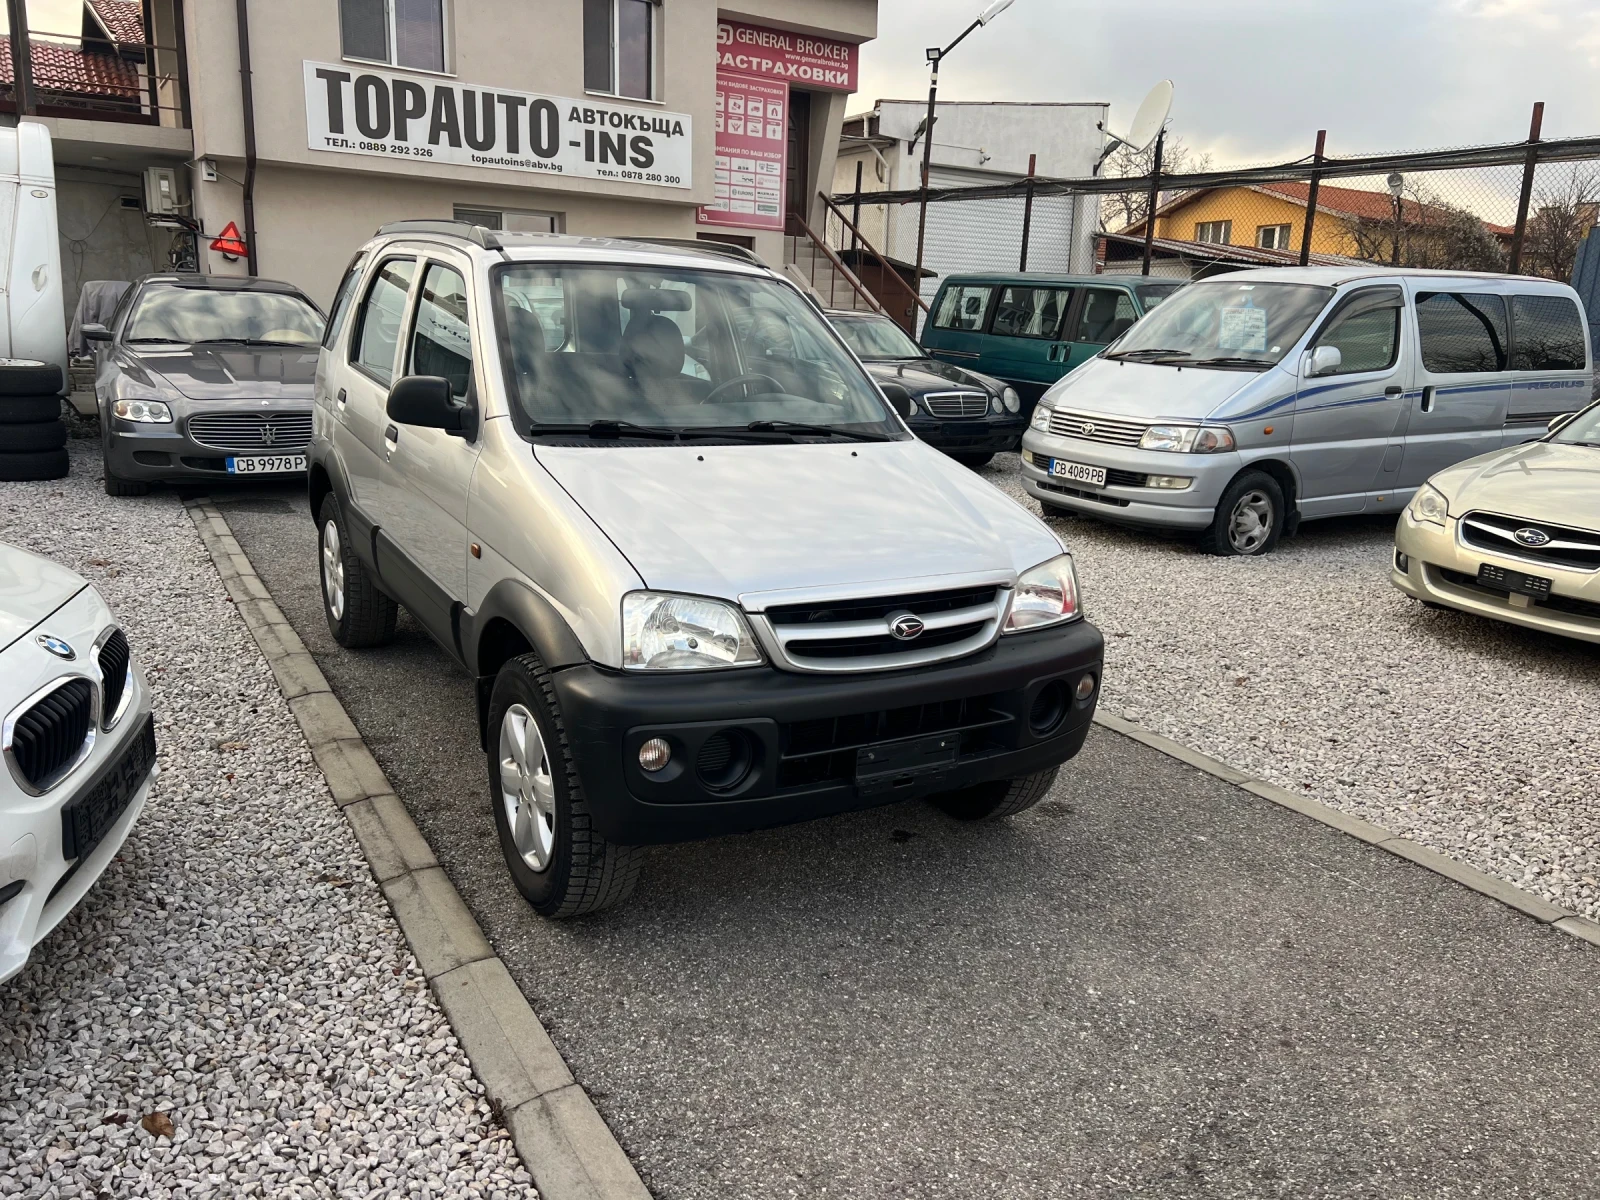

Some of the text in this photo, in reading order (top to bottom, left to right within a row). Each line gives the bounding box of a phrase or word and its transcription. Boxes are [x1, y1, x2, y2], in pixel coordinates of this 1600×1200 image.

[736, 28, 849, 61] GENERAL BROKER
[785, 52, 848, 70] www.generalbroker.bg
[749, 85, 784, 95] ЗАСТРАХОВКИ
[316, 68, 560, 158] TOPAUTO
[568, 106, 684, 138] АВТОКЪЩА
[324, 137, 433, 157] ТЕЛ.: 0889 292 326
[569, 129, 655, 169] -INS
[716, 146, 740, 155] МПАНИЯ
[471, 153, 563, 172] topautoins@abv.bg
[597, 169, 681, 184] тел.: 0878 280 300
[1527, 380, 1585, 390] REGIUS
[236, 459, 256, 472] CB
[258, 457, 292, 471] 9978
[1054, 461, 1067, 475] CB
[1068, 464, 1090, 480] 4089
[1091, 469, 1104, 483] PB
